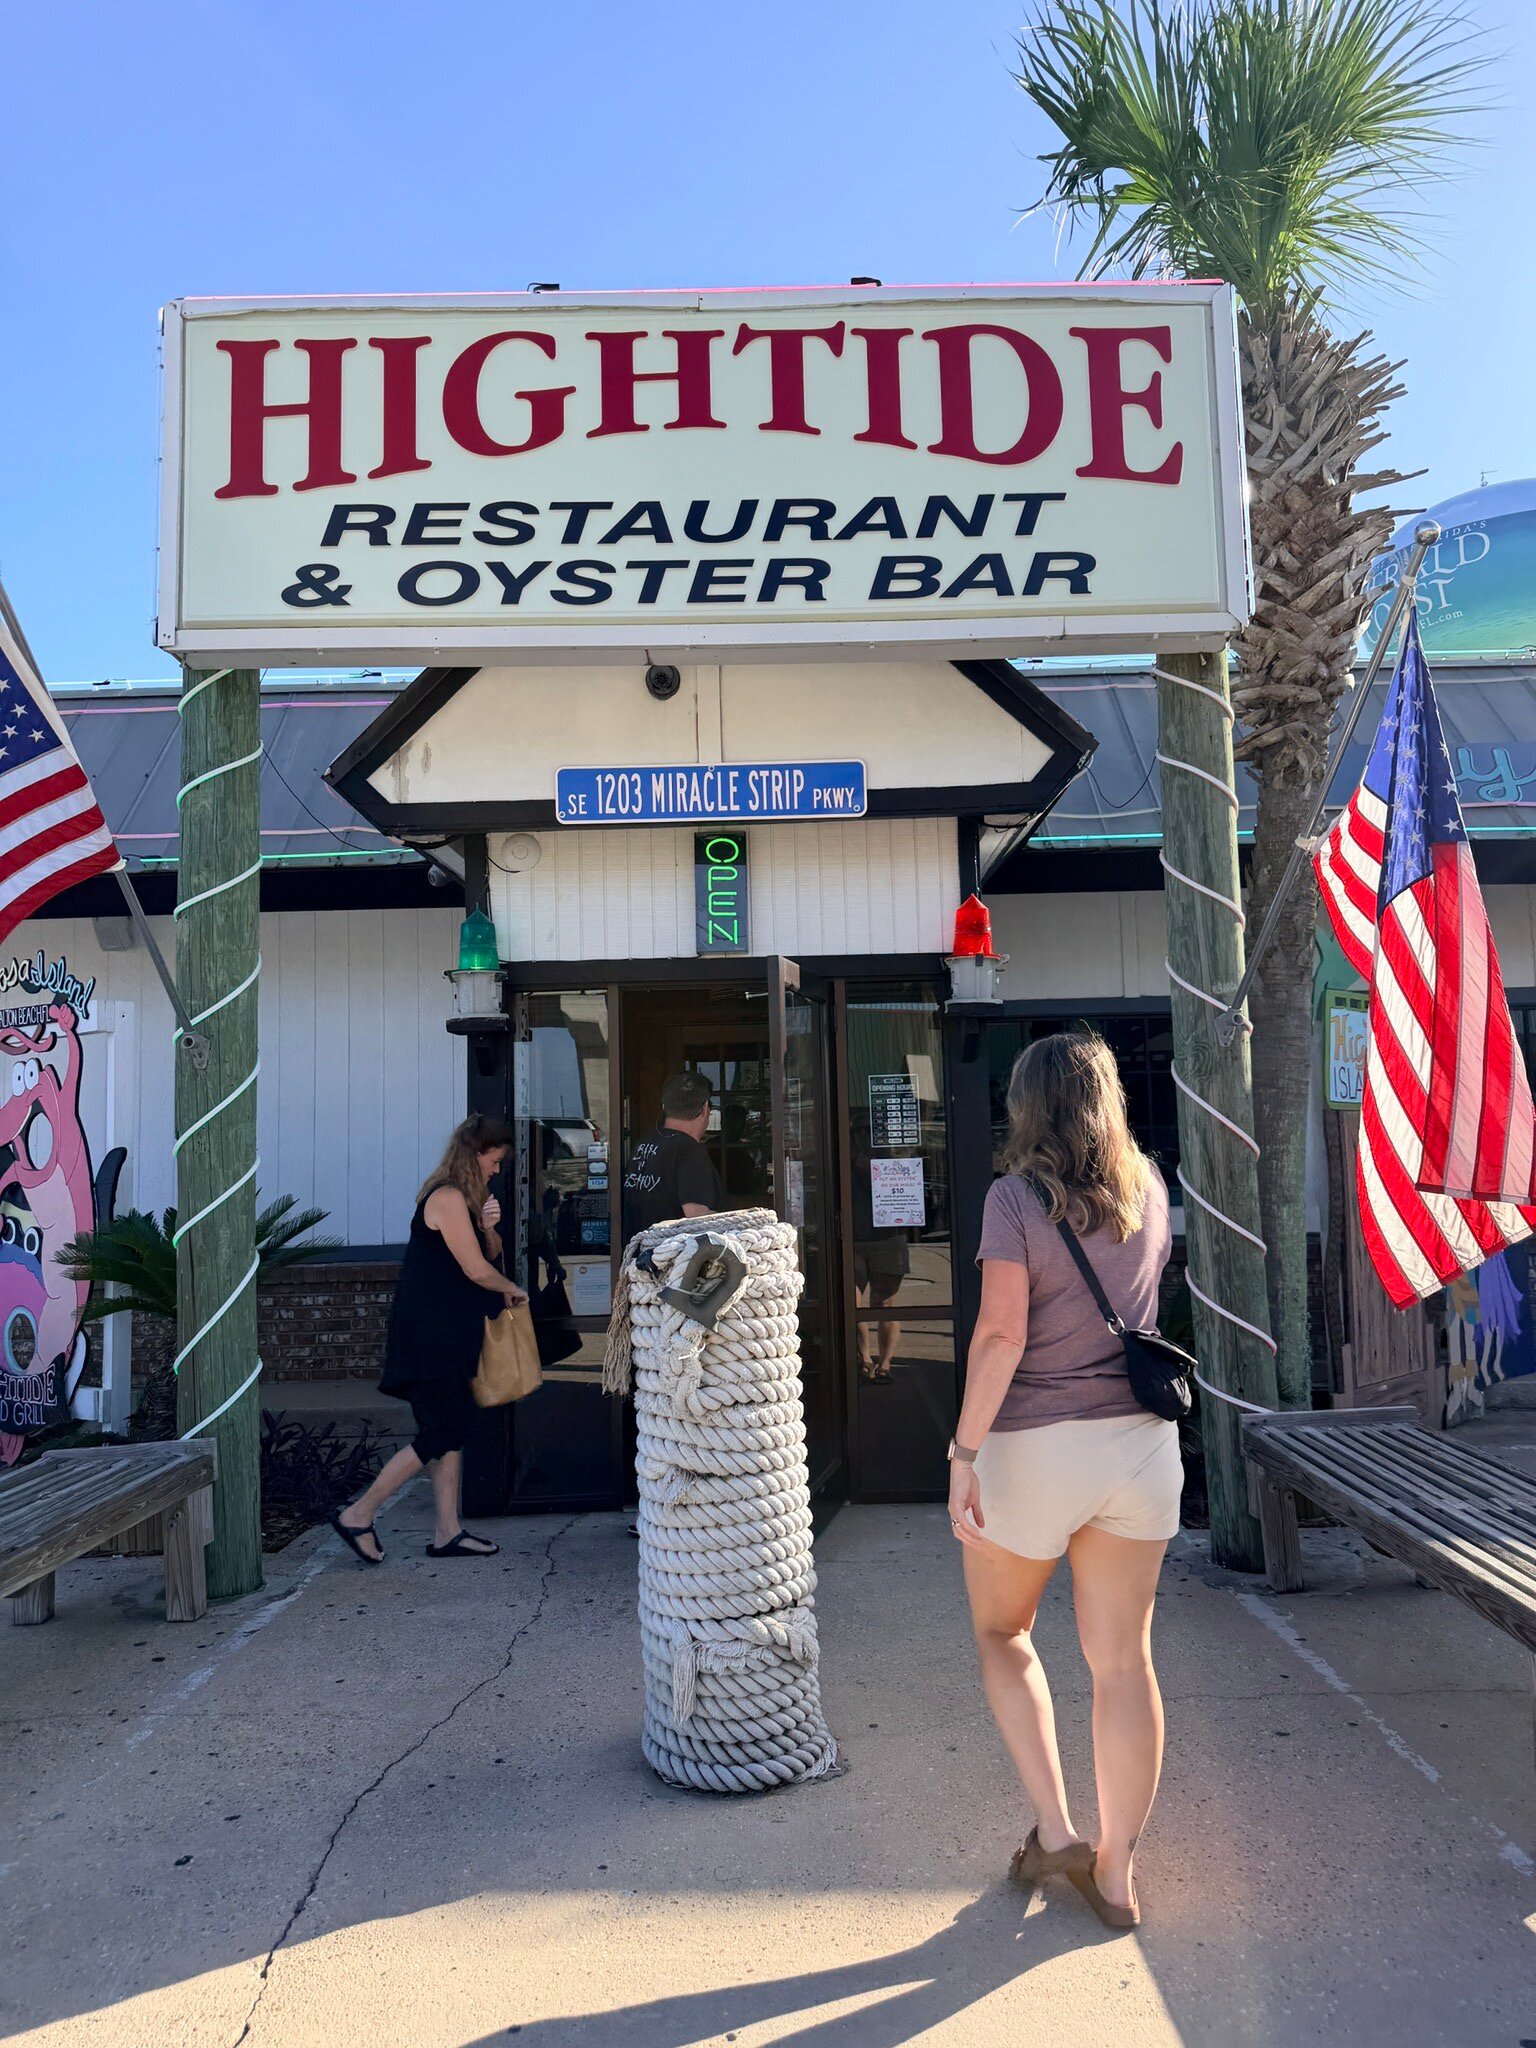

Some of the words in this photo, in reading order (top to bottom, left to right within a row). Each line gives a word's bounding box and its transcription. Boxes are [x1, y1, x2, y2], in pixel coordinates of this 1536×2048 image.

[215, 322, 1184, 499] HIGHTIDE
[320, 493, 1067, 547] RESTAURANT
[281, 563, 353, 608] &
[397, 557, 832, 607] OYSTER
[869, 551, 1097, 600] BAR
[567, 794, 588, 815] SE
[596, 773, 643, 814] 1203
[651, 771, 740, 813] MIRACLE
[748, 769, 805, 811] STRIP
[813, 787, 855, 809] PKWY
[705, 837, 740, 945] OPEN
[19, 1005, 42, 1025] BEACH
[42, 1004, 51, 1023] FL
[13, 1402, 47, 1426] GRILL
